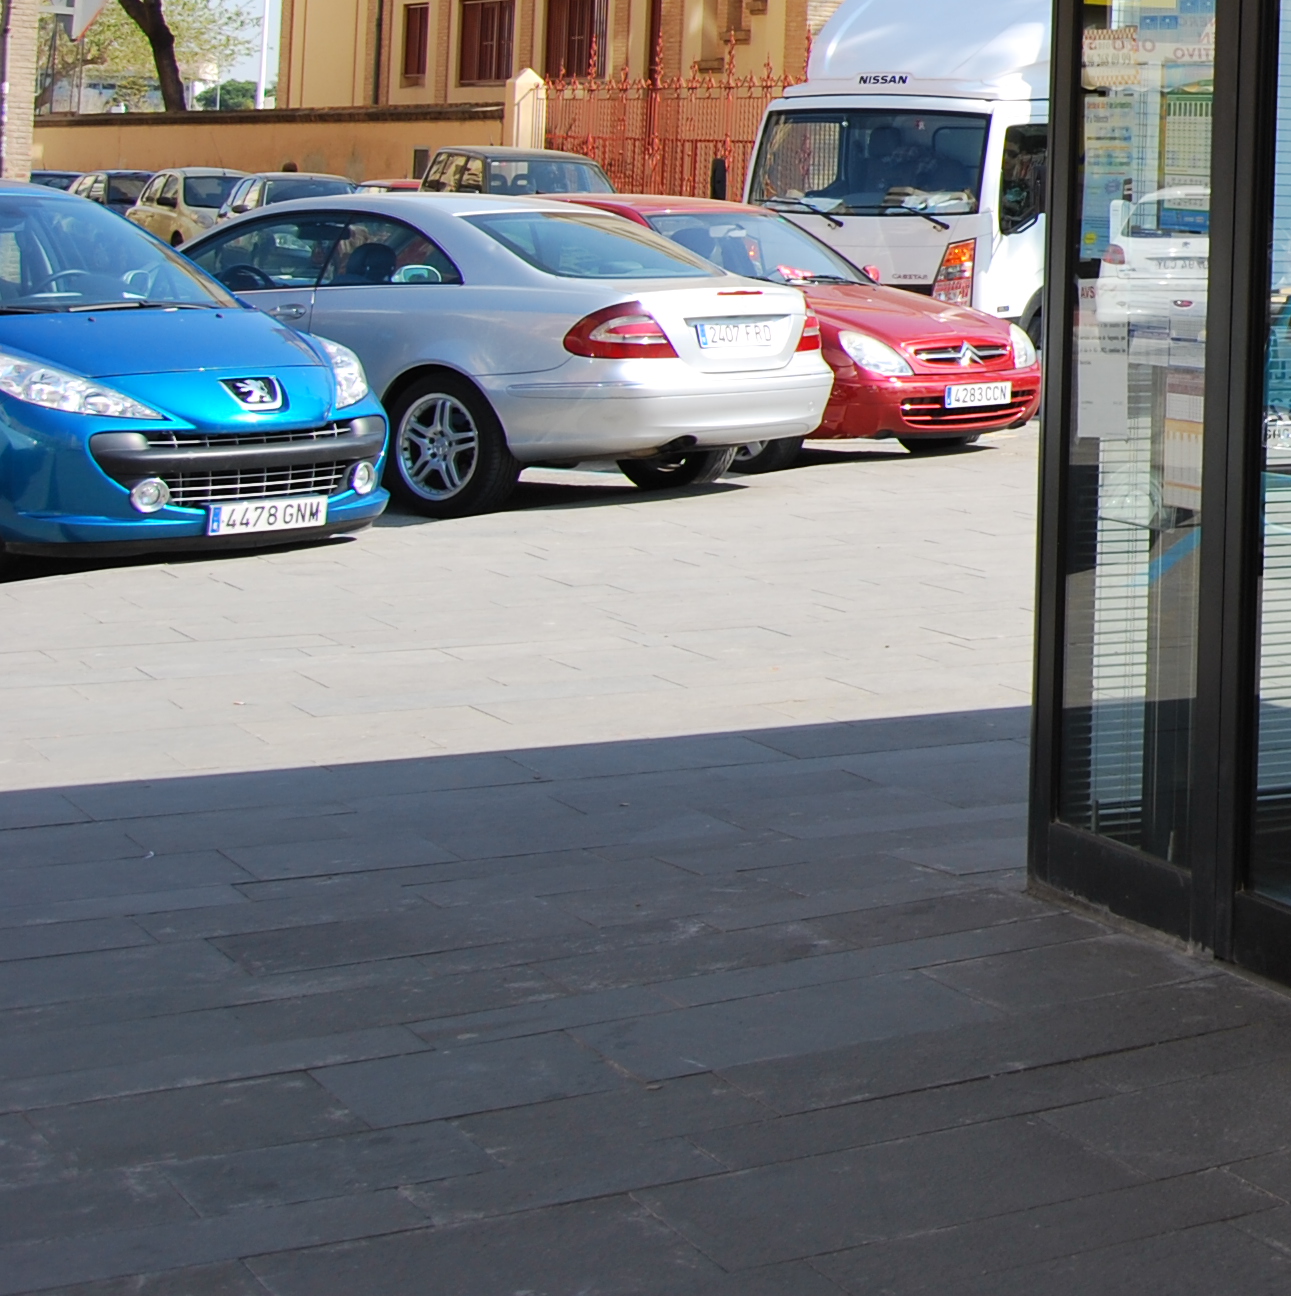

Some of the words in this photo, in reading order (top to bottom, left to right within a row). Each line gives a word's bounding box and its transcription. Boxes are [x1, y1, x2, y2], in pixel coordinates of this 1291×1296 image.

[859, 75, 908, 85] NISSAN
[709, 325, 740, 343] 2407
[954, 387, 983, 403] 4283
[984, 384, 1007, 401] CCN
[225, 505, 279, 529] 4478
[282, 501, 320, 524] GNM
